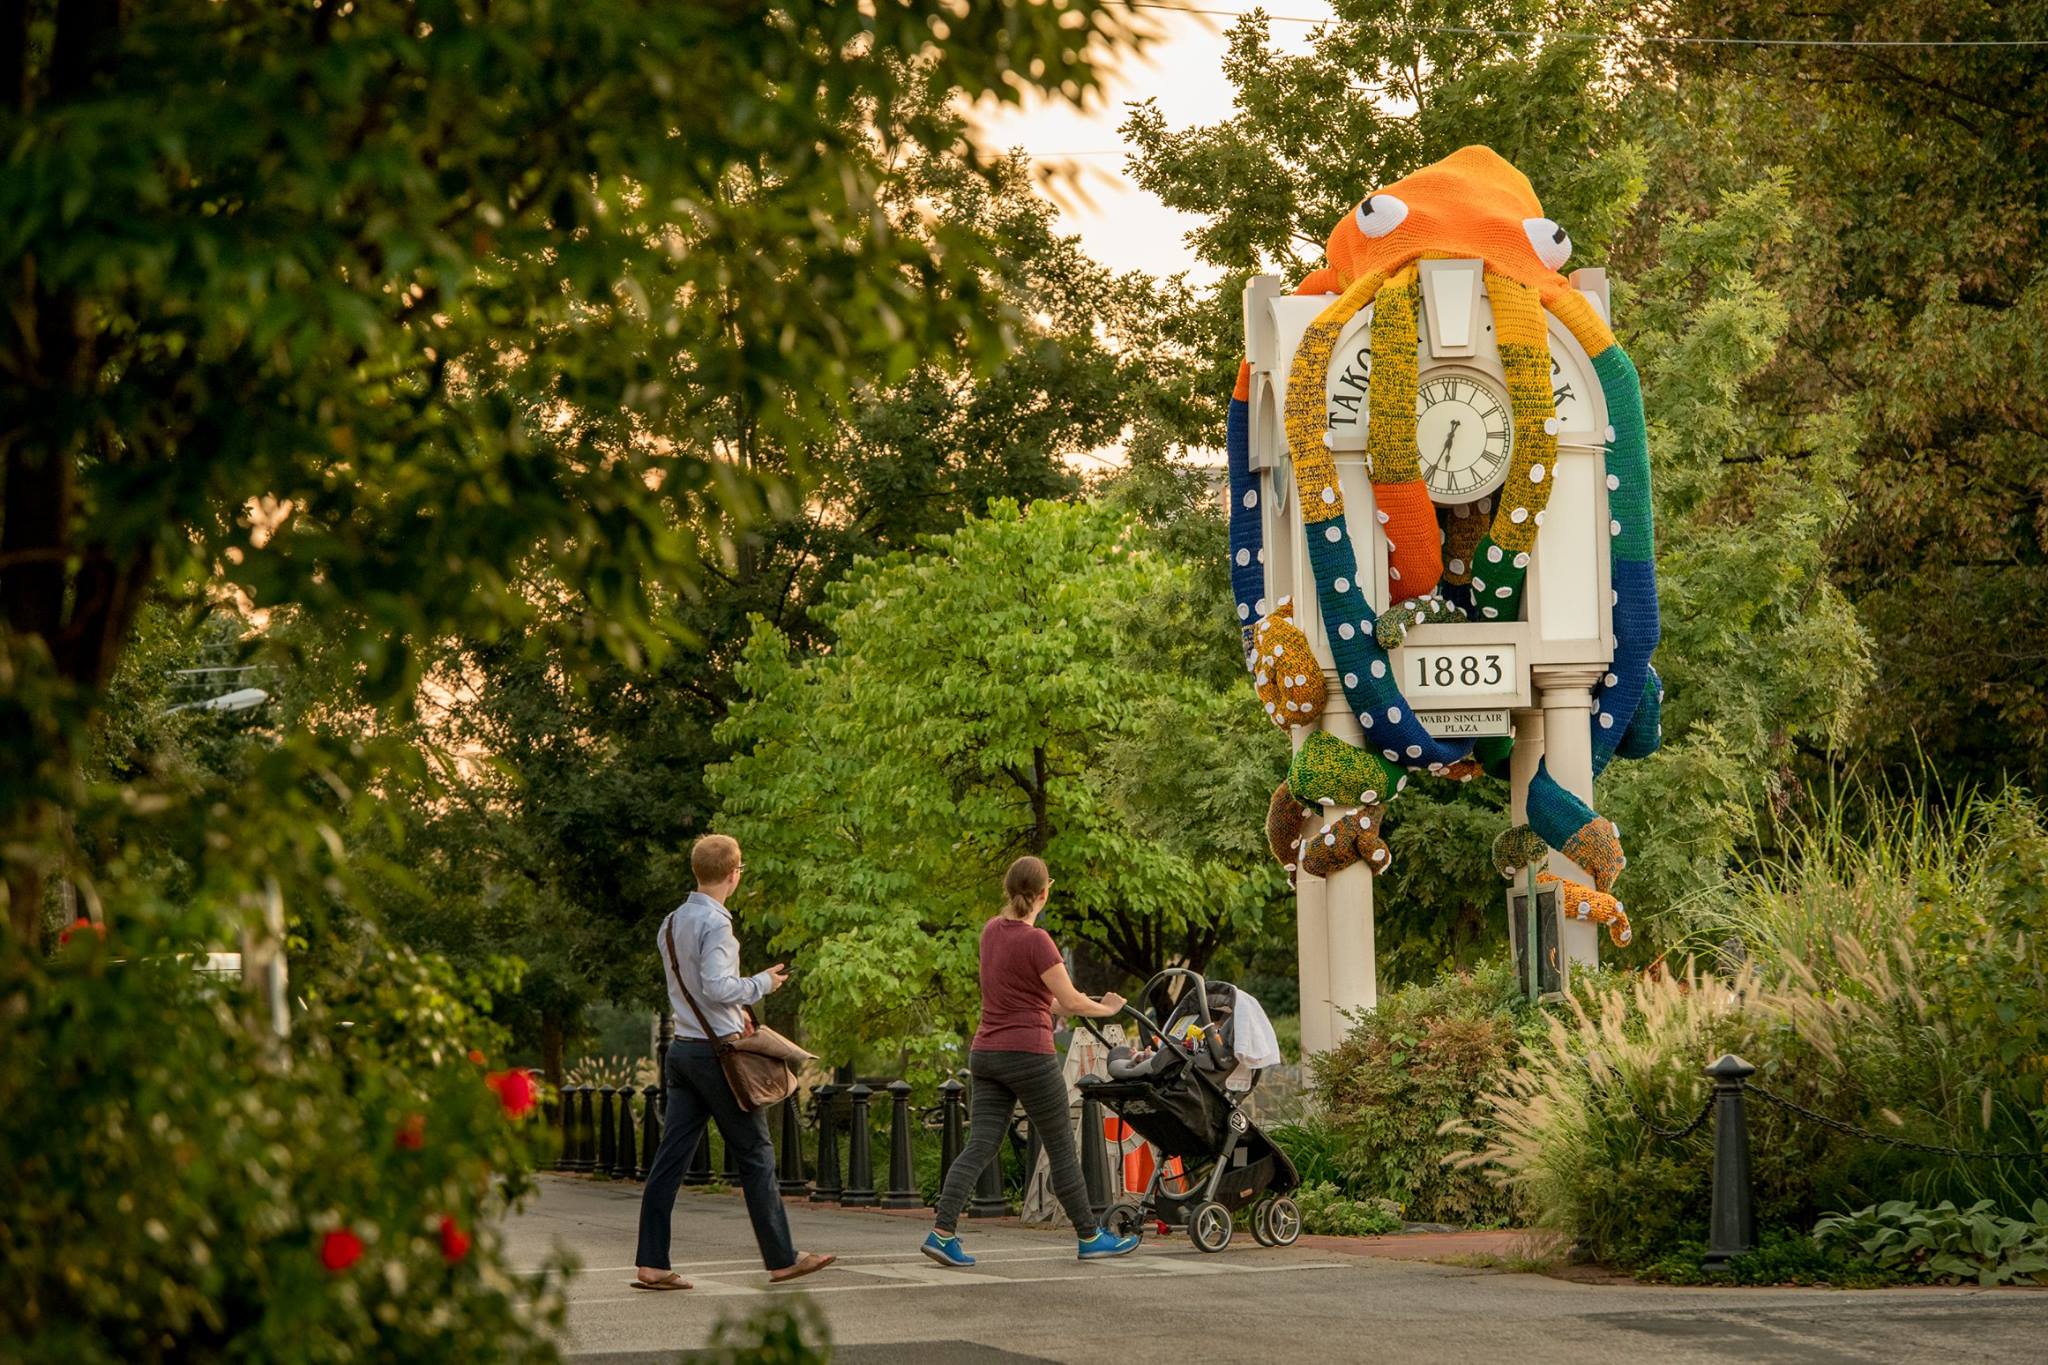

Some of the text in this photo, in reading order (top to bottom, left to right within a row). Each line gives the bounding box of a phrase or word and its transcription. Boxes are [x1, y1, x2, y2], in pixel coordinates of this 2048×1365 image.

[1417, 655, 1503, 687] 1883
[1420, 713, 1502, 723] WARD SINCLAIR
[1445, 724, 1479, 733] PLAZA
